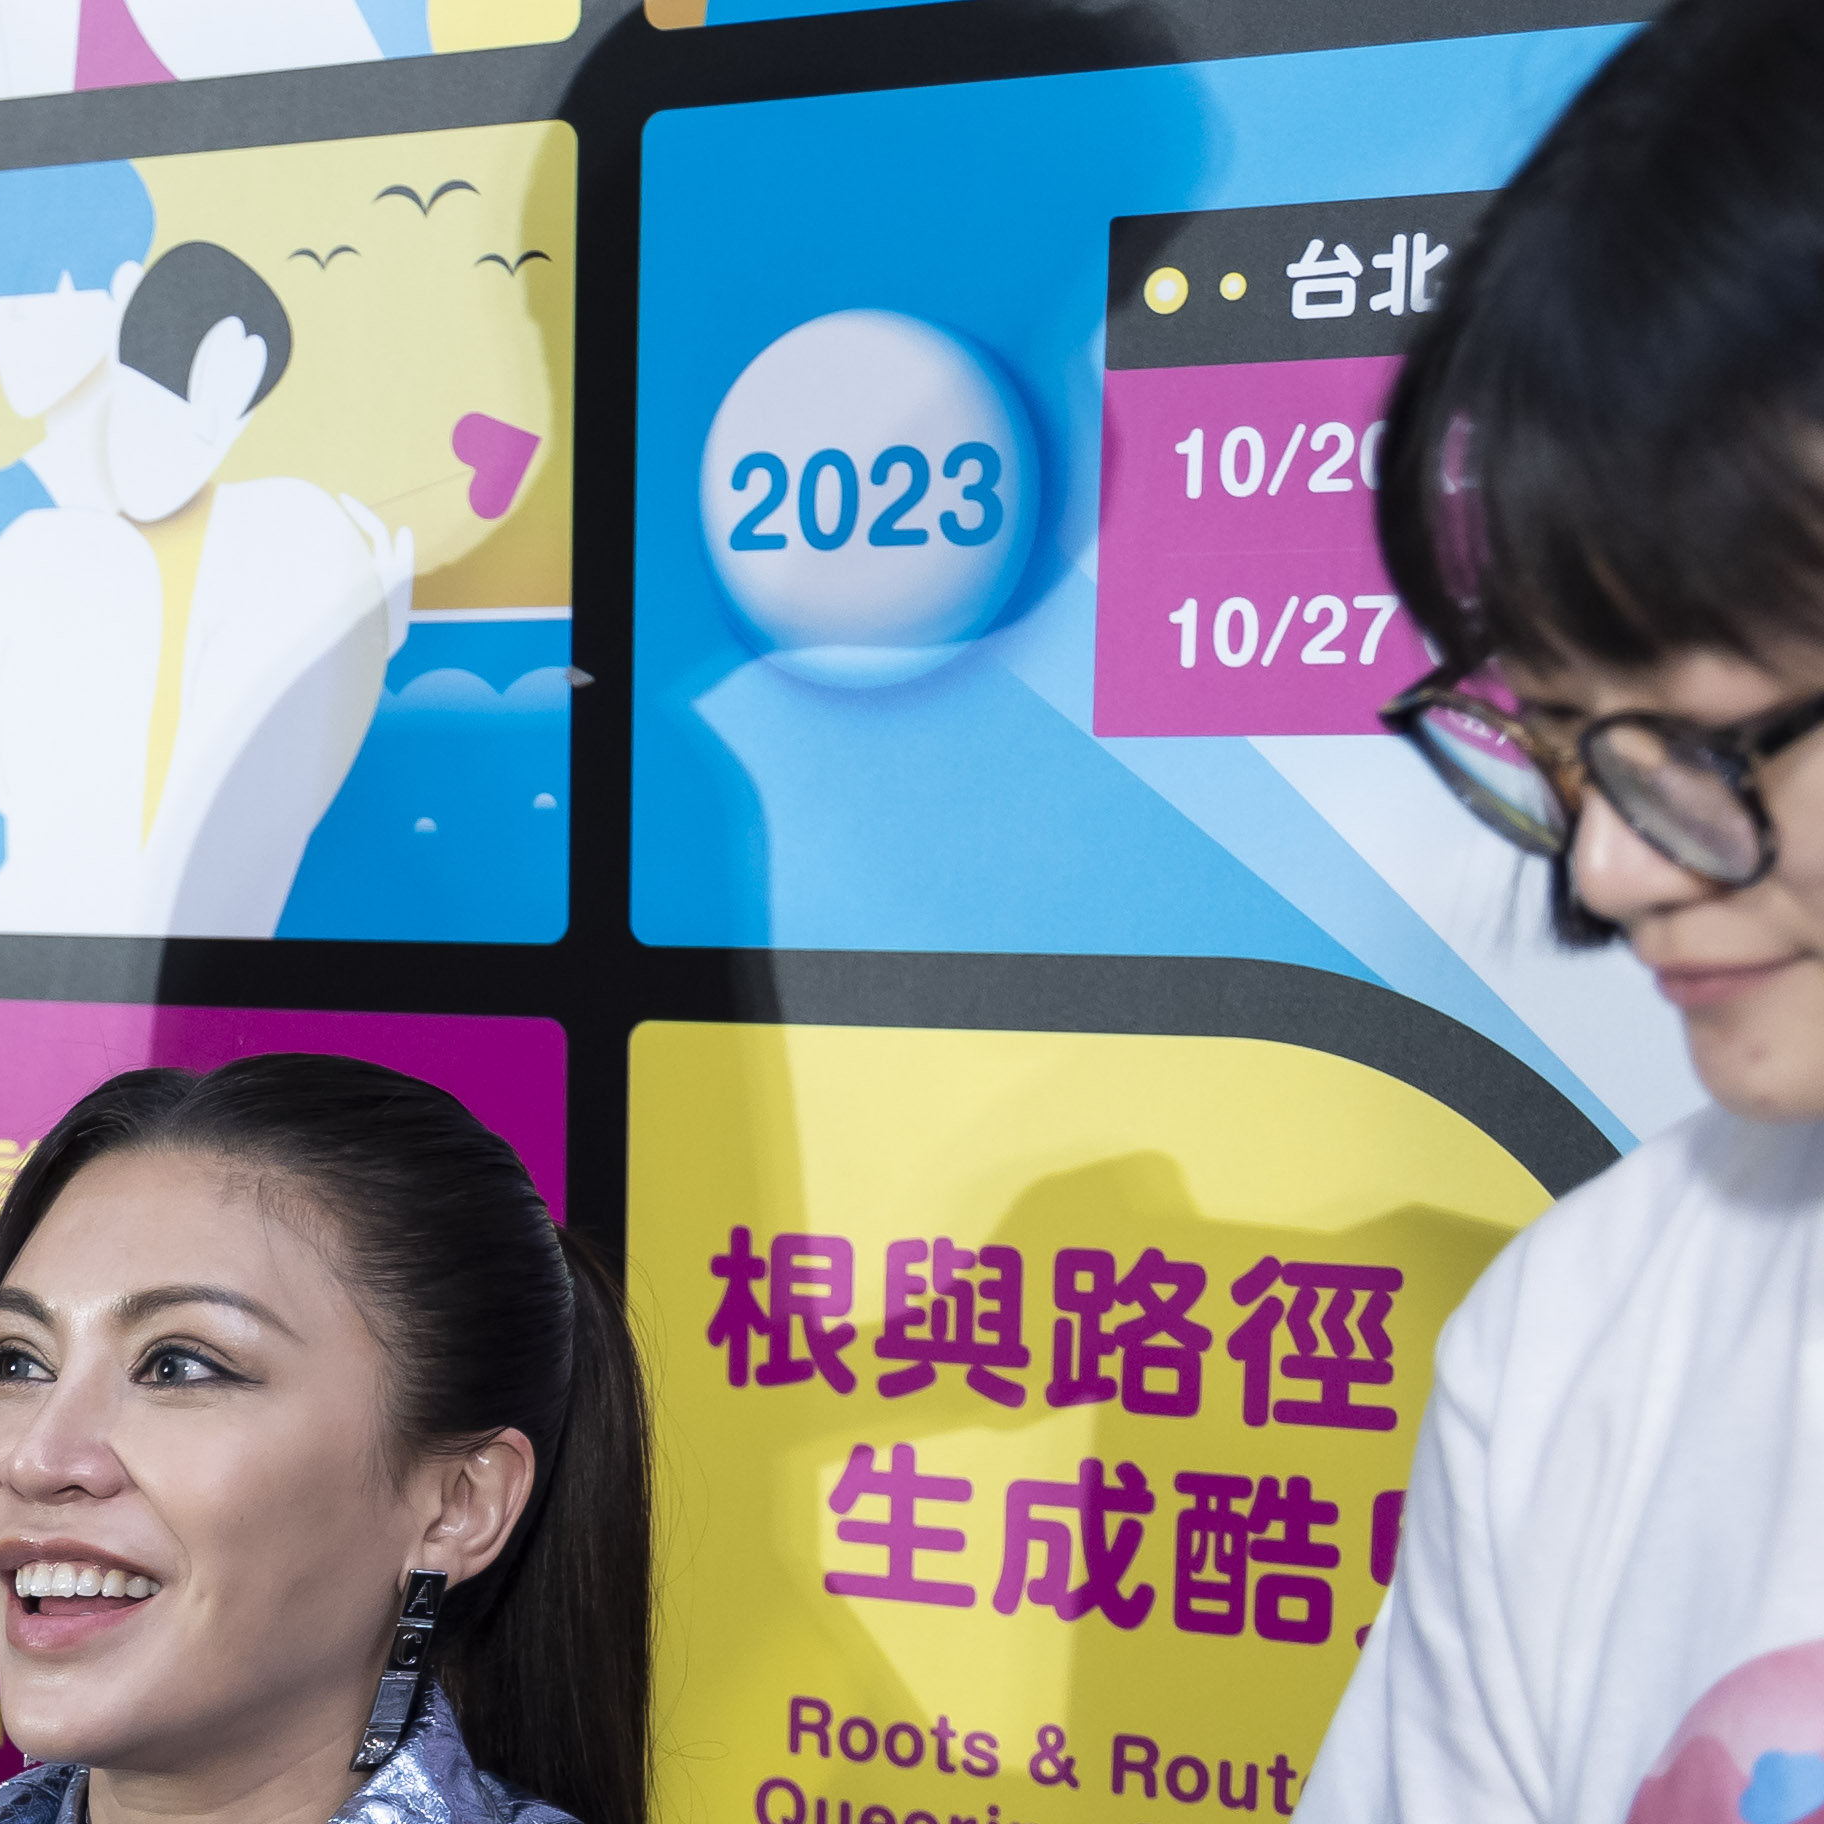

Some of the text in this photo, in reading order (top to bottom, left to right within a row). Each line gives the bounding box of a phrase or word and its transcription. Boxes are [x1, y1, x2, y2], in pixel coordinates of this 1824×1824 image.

[1286, 232, 1451, 321] 台北
[729, 442, 1004, 553] 2023
[1167, 594, 1402, 670] 10/27
[707, 1222, 1404, 1432] 根與路徑
[788, 1695, 1309, 1817] Roots & Rout
